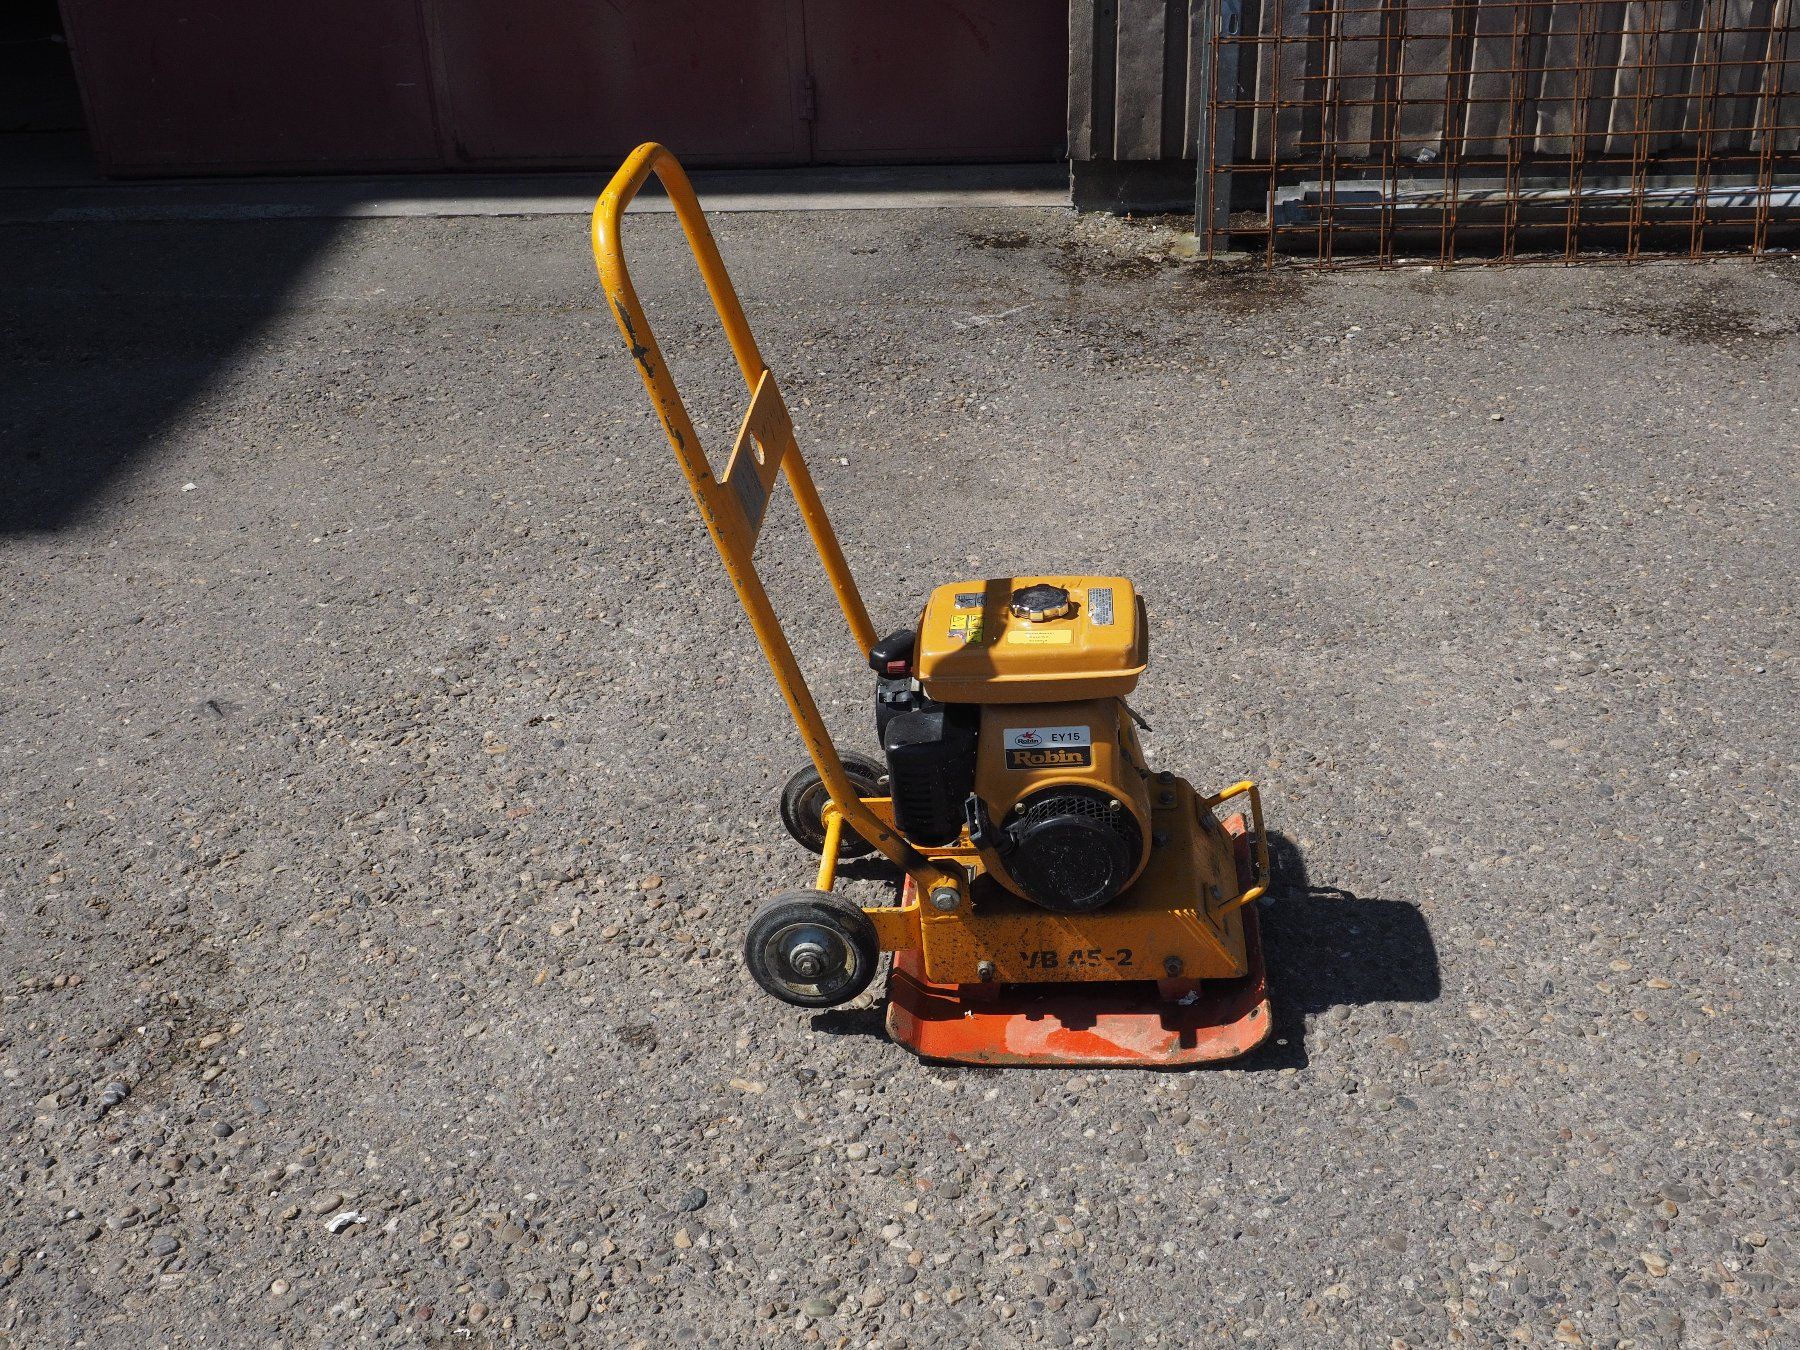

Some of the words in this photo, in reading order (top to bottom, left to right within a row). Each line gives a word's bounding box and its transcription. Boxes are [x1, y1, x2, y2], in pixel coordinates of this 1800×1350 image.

[1051, 732, 1080, 742] EY15
[1013, 749, 1084, 767] Robin
[1019, 949, 1059, 969] VB
